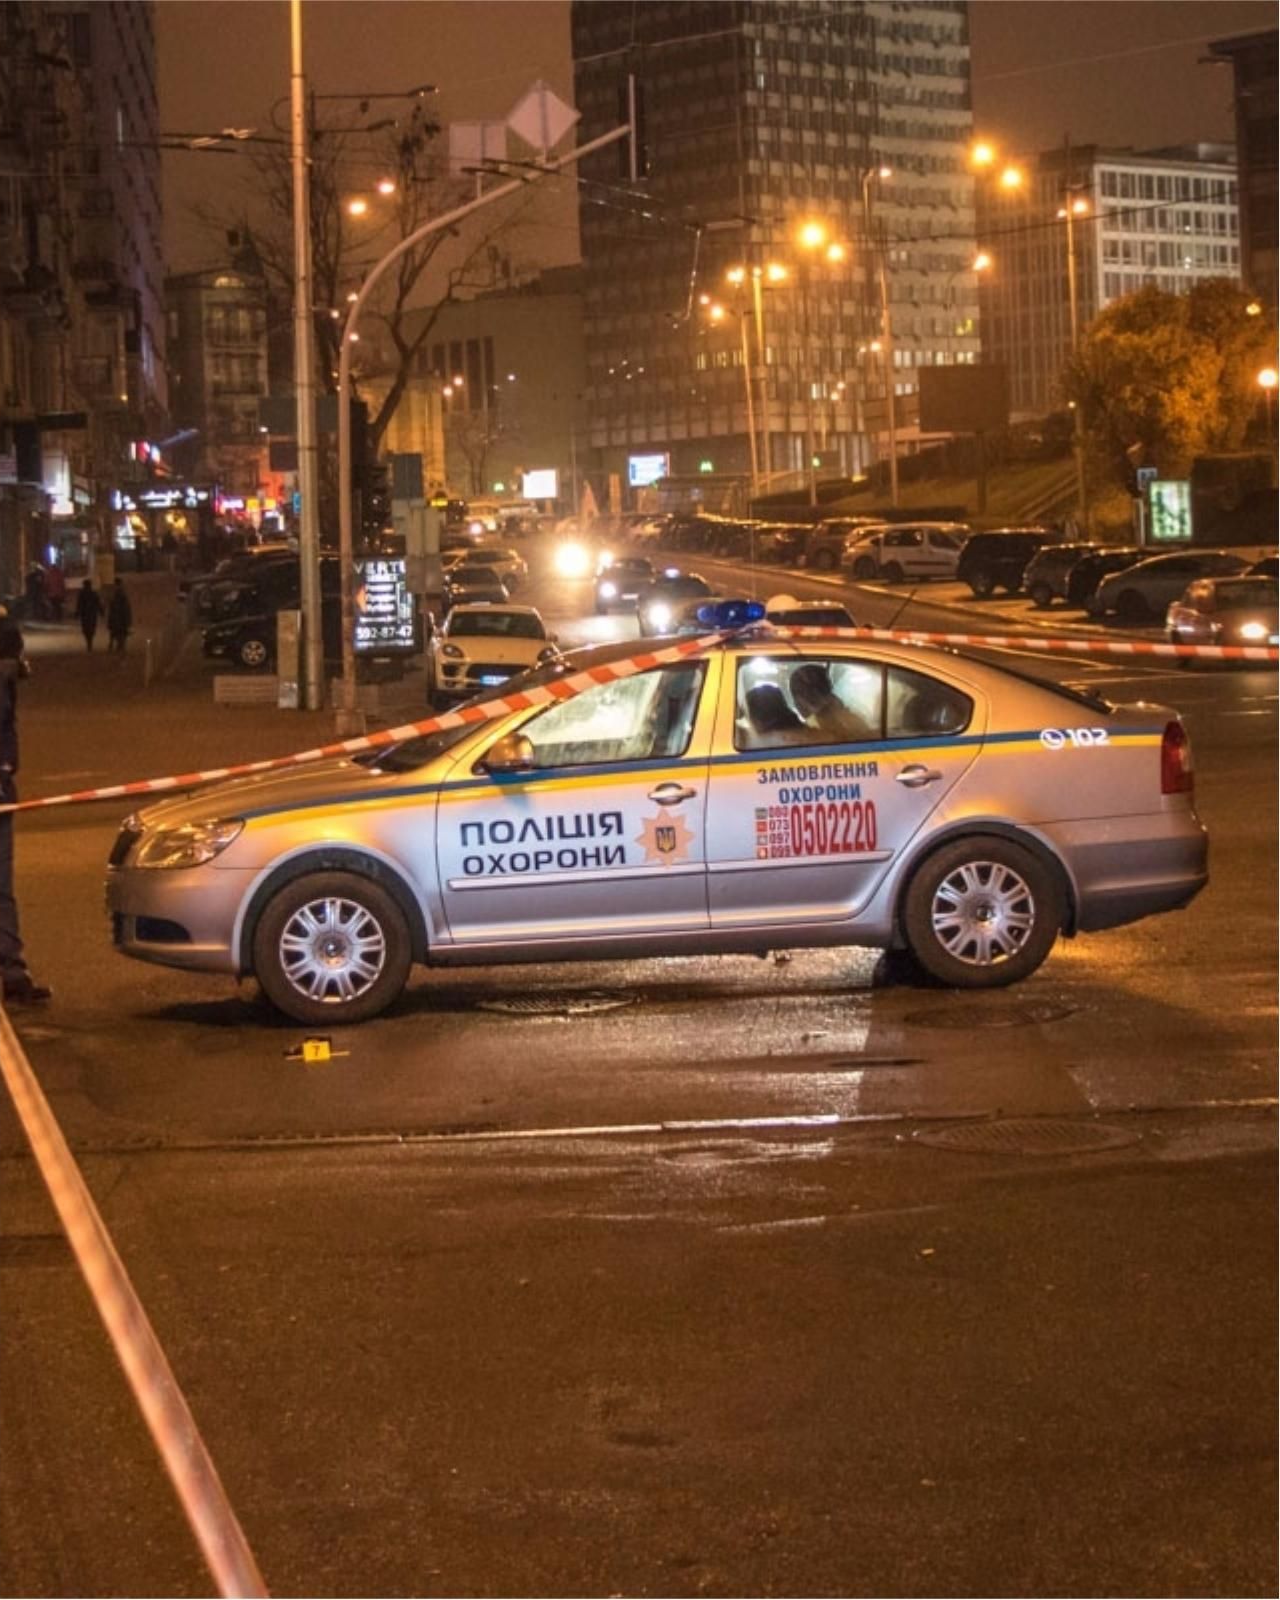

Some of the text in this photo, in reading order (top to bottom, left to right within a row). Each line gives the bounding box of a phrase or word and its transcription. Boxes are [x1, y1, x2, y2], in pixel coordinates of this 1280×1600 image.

[1065, 727, 1111, 748] 102
[757, 761, 879, 784] ЗАМОВЛЕННЯ
[778, 783, 862, 804] ОХОРОНИ
[460, 811, 624, 847] ПОЛІЦІЯ
[791, 800, 877, 855] 0502220
[462, 845, 626, 875] ОХОРОНИ
